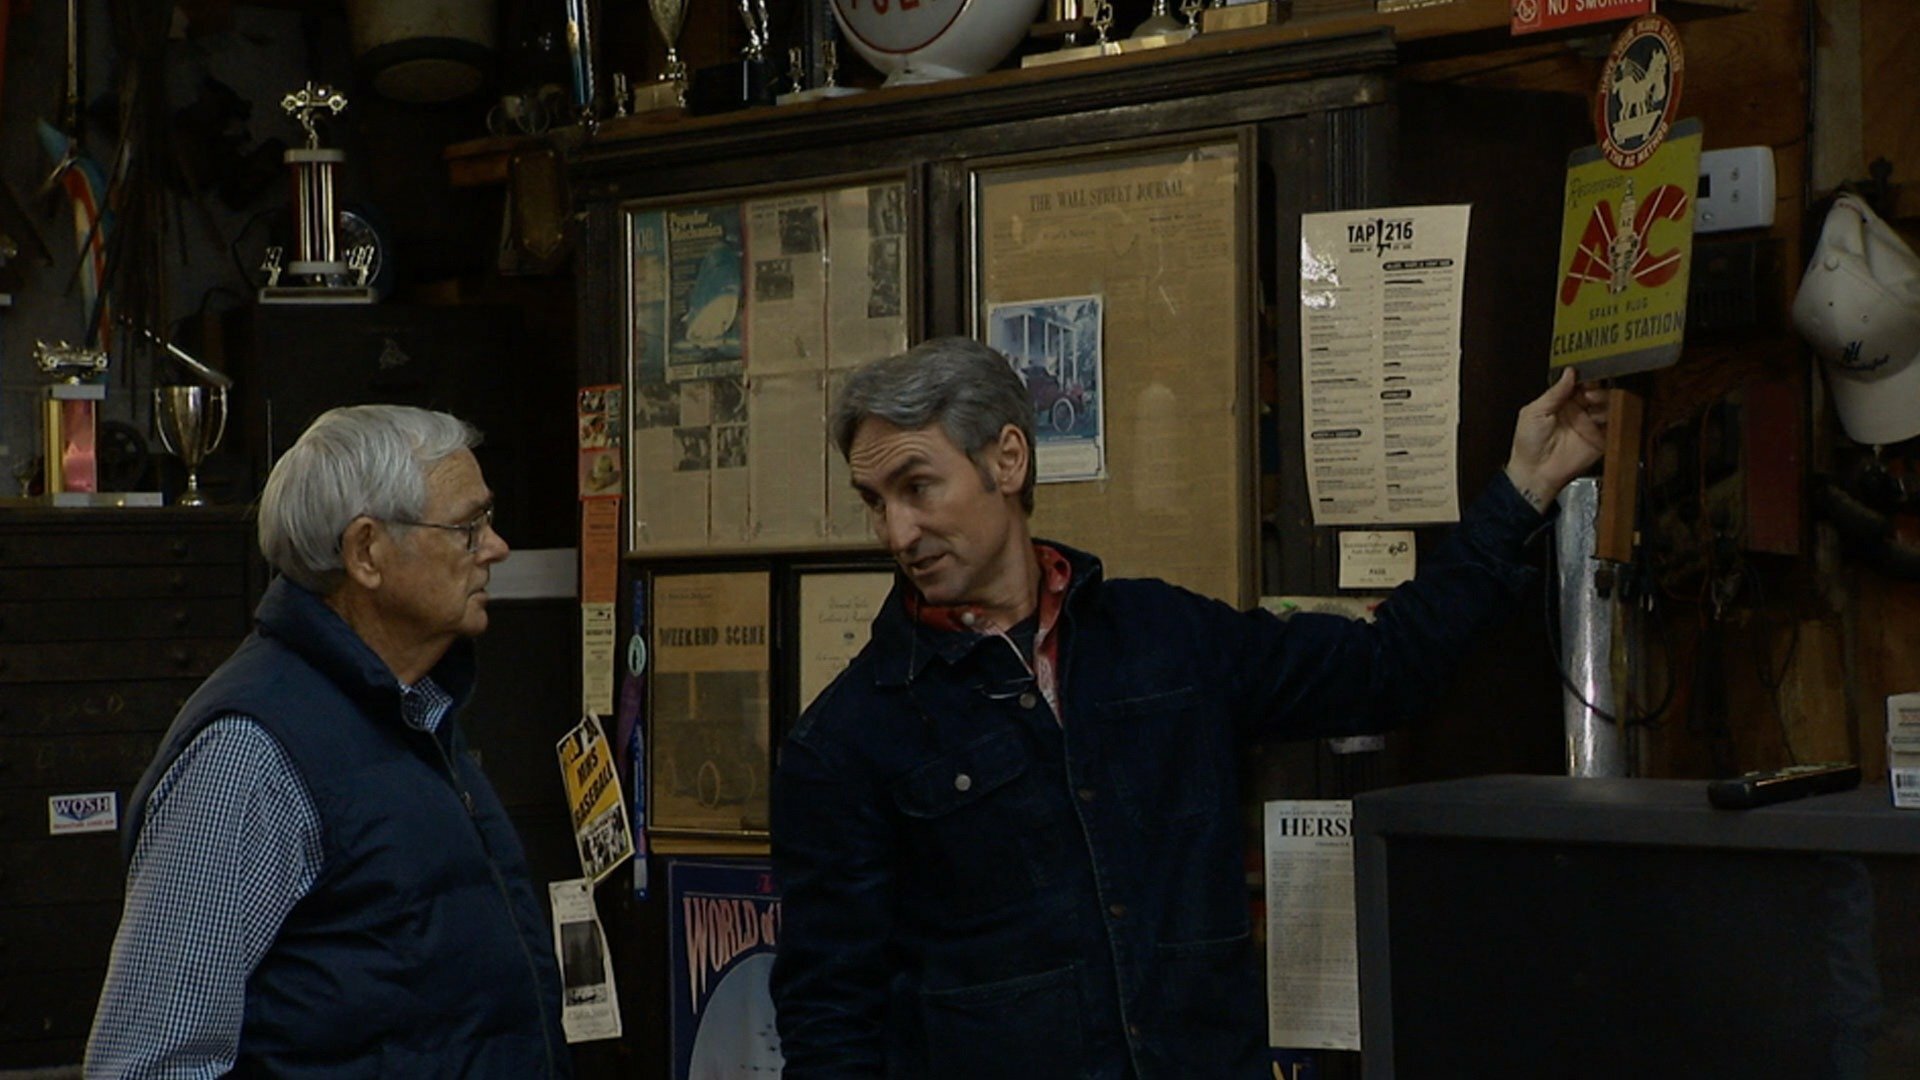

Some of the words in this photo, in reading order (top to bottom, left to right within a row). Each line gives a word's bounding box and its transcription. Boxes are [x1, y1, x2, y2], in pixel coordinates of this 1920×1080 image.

[1029, 193, 1051, 212] THE
[1056, 188, 1087, 208] WALL
[1090, 184, 1131, 206] STREET
[1136, 179, 1185, 202] JOURNAL
[1348, 225, 1375, 242] TAP
[1385, 221, 1412, 240] 216
[1553, 324, 1619, 356] CLEANING
[1625, 311, 1684, 342] STATION
[659, 627, 718, 648] WEEKEND
[726, 625, 765, 646] SCENE
[52, 797, 111, 818] WOSH
[574, 760, 613, 830] BASEBALL
[683, 896, 760, 1015] WORLD
